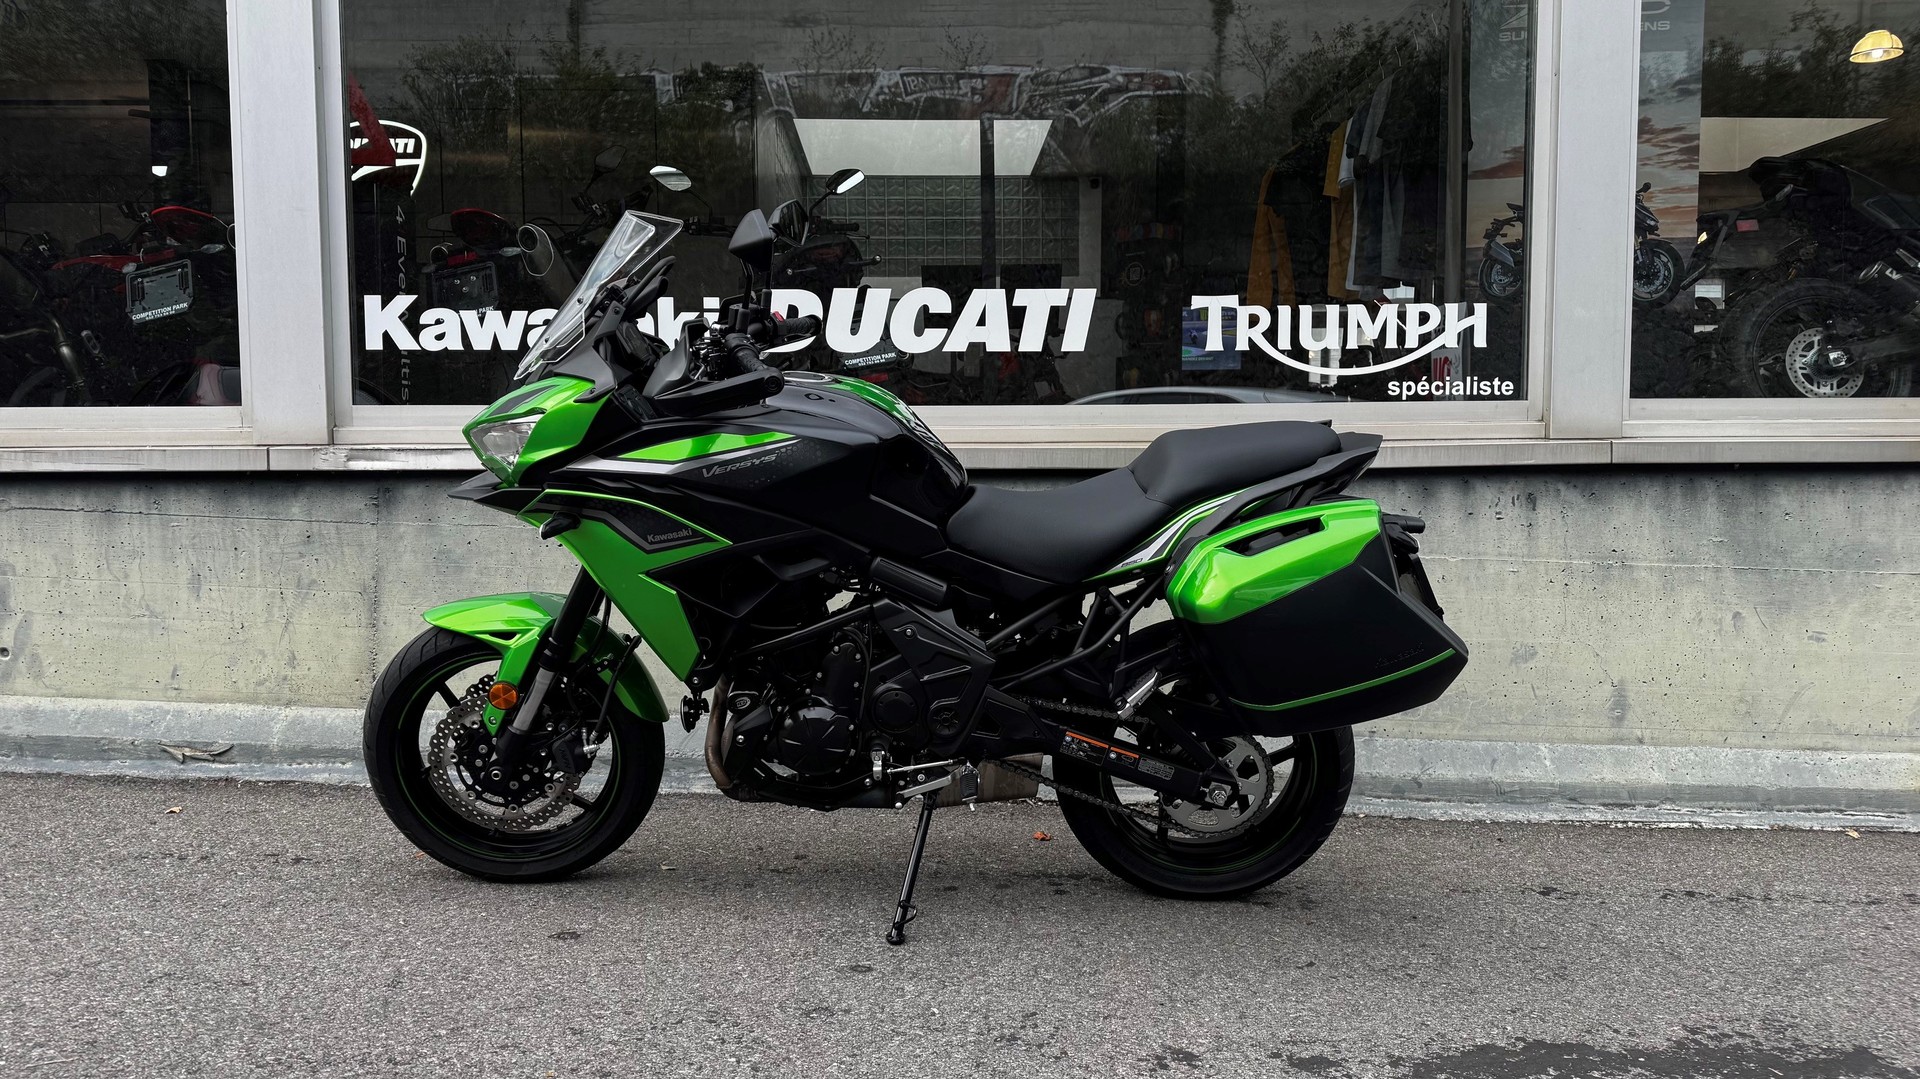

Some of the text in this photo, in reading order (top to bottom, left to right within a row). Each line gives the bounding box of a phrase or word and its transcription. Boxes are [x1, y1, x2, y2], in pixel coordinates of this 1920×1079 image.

[132, 306, 172, 320] COMPETITION
[172, 302, 188, 311] PARK
[1190, 295, 1488, 375] TRIUMPH
[845, 354, 881, 366] COMPETITION
[882, 351, 897, 360] PARK
[1387, 376, 1515, 400] spécialiste
[701, 453, 778, 478] VERSYS
[647, 528, 692, 543] Kawasaki
